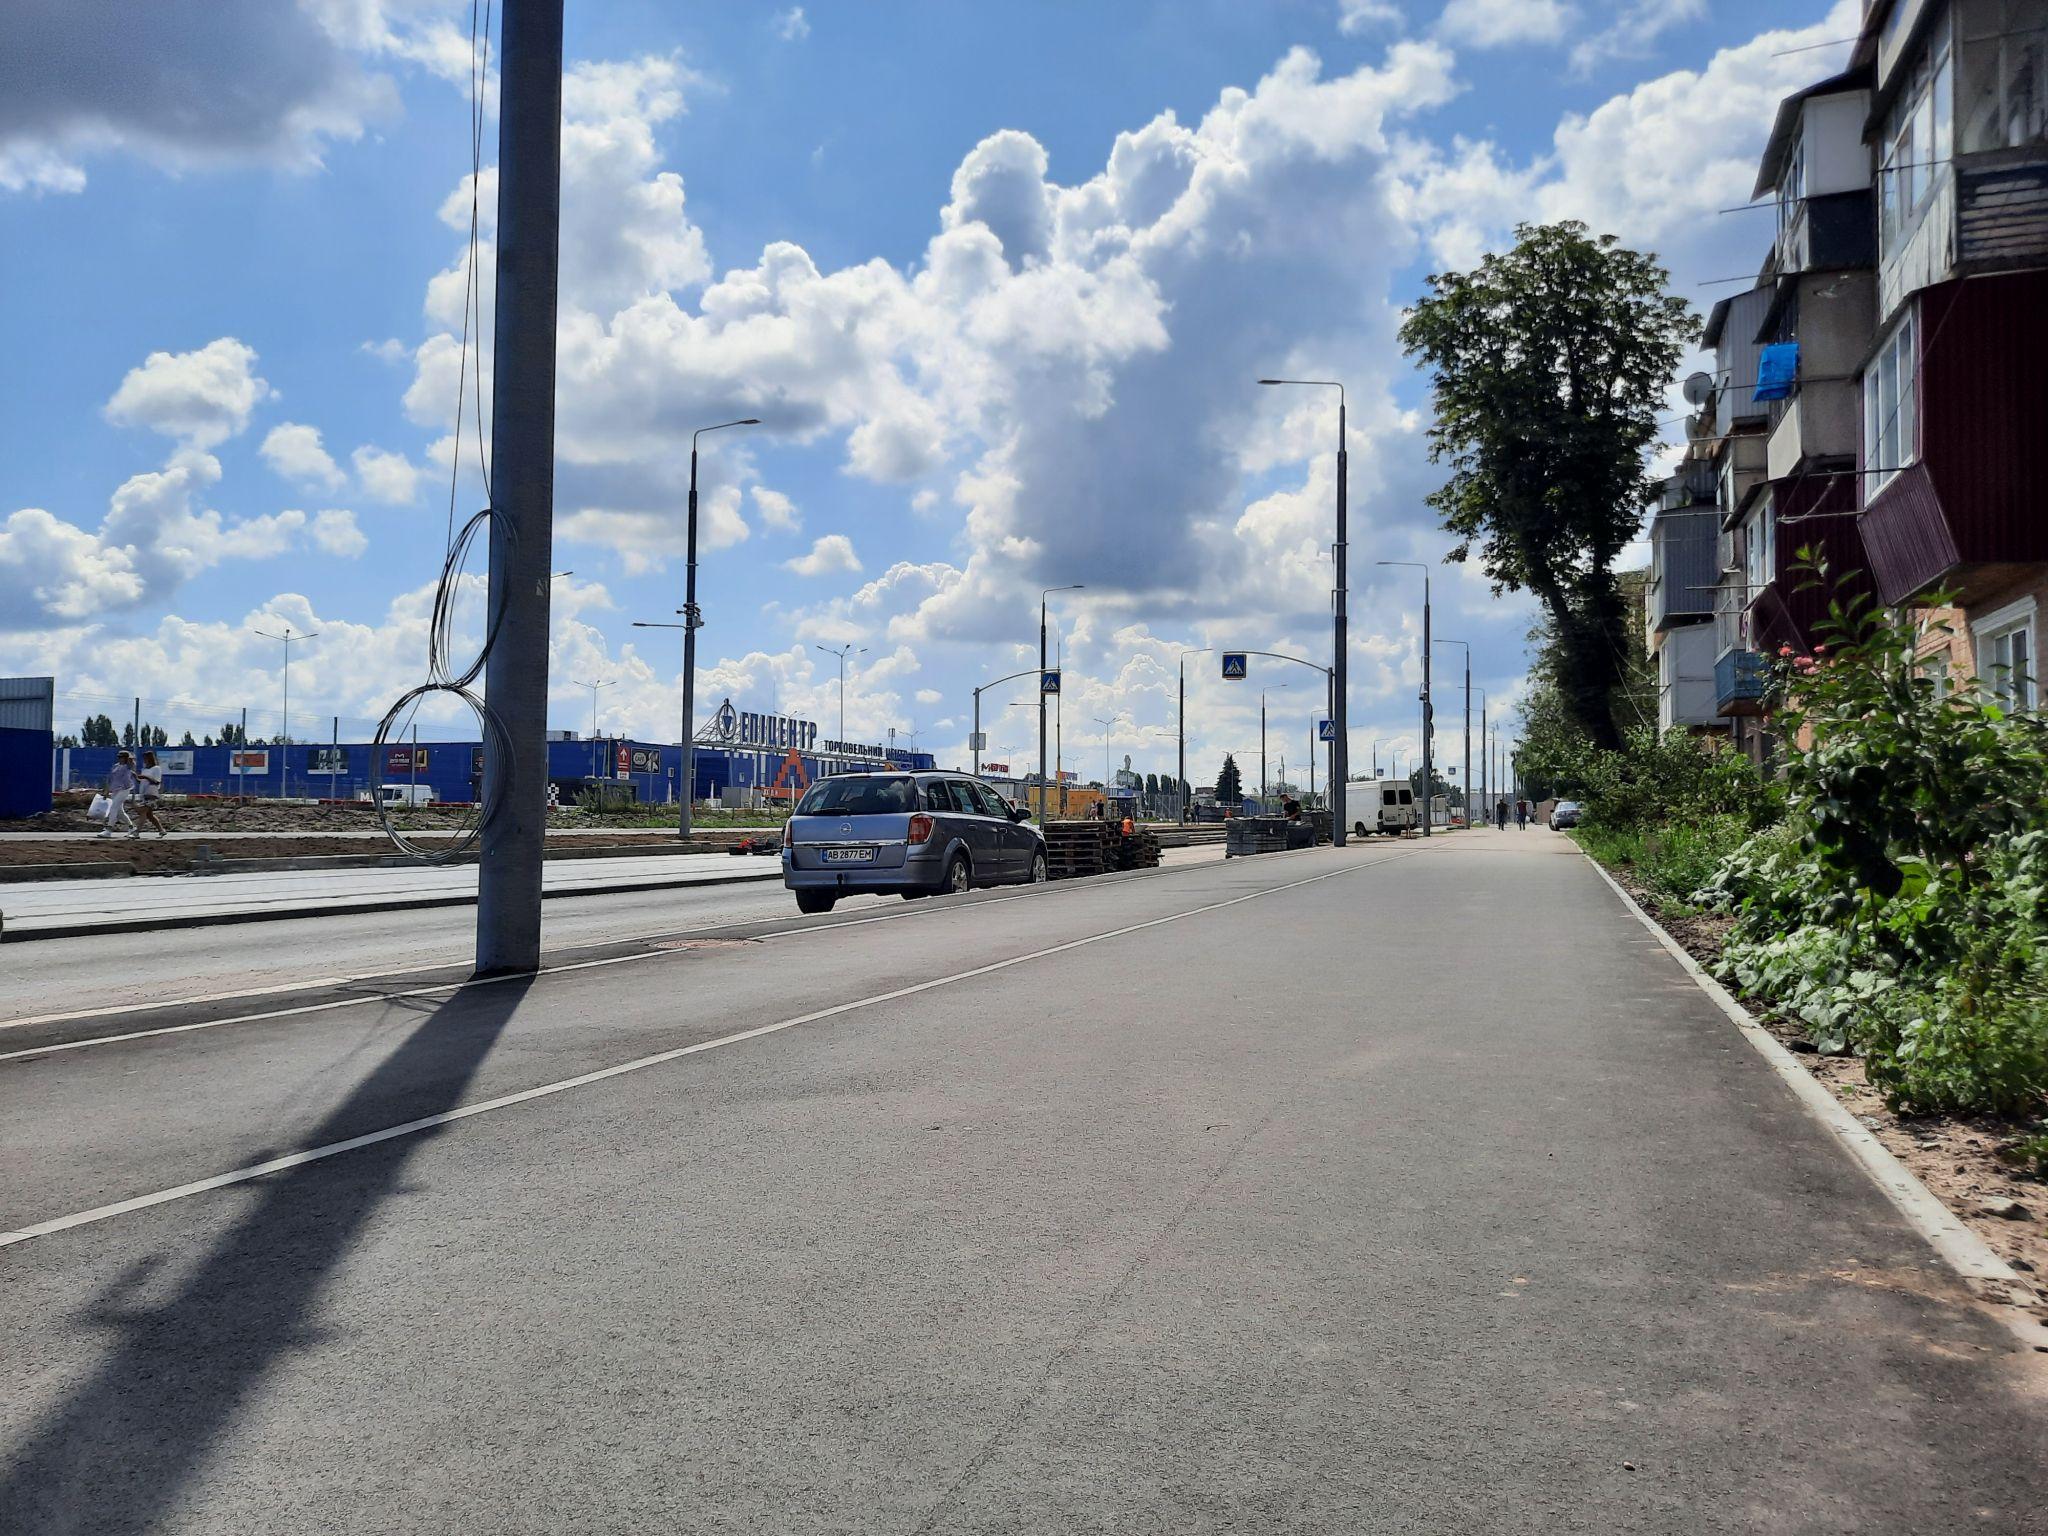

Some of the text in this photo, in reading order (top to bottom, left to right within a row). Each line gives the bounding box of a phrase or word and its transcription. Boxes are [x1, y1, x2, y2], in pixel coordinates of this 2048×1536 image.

[740, 712, 817, 750] ЕПІЦЕНТР
[824, 740, 883, 758] ТОРГОВЕЛЬНИЙ
[828, 851, 839, 859] AB
[859, 850, 872, 859] EM
